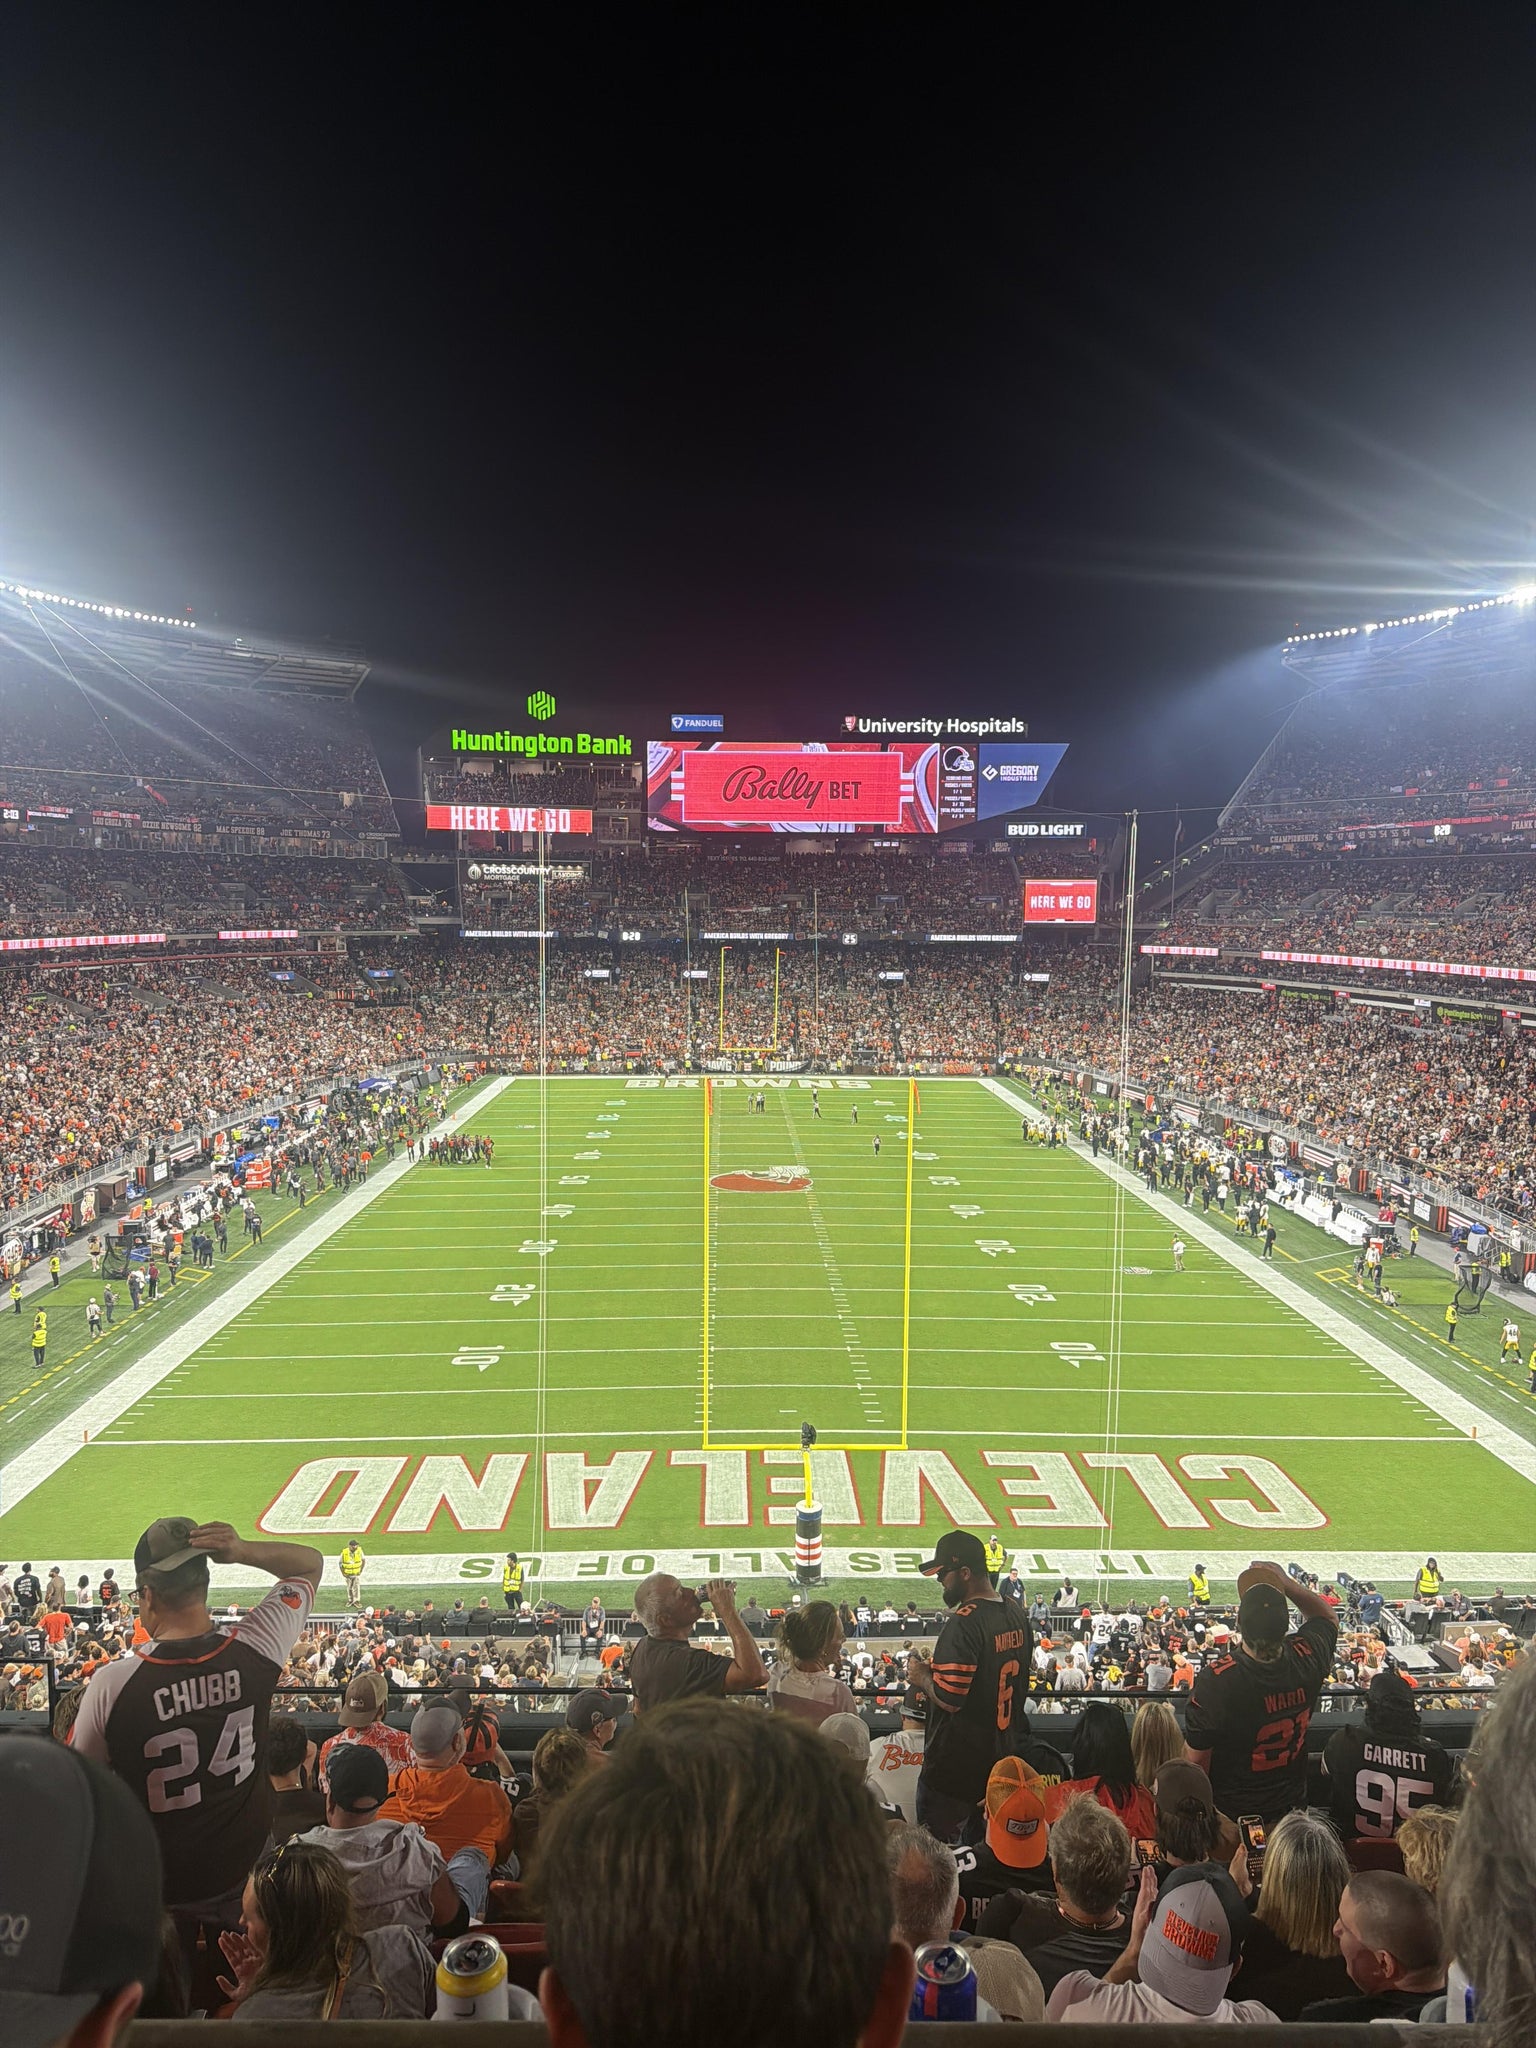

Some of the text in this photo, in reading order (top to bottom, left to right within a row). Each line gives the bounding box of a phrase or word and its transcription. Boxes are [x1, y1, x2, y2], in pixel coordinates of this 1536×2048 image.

[685, 719, 723, 728] FANDUEL
[859, 718, 1025, 737] University Hospitals
[452, 730, 632, 757] Huntington Bank
[1000, 765, 1039, 777] GREGORY
[722, 765, 862, 809] Bally BET
[161, 822, 191, 831] NEWSOME
[194, 824, 202, 832] 82
[450, 806, 571, 833] HERE WE GO
[1512, 820, 1533, 830] FRANK
[230, 826, 255, 834] SPEEDIE
[280, 829, 330, 838] JOE THOMAS 73
[1008, 824, 1084, 836] BUD LIGHT
[483, 866, 551, 875] CROSSCOUNTRY
[1031, 896, 1091, 910] HERE WE GO
[844, 934, 856, 944] 25
[624, 1078, 873, 1089] BROWNS
[489, 1284, 536, 1302] 20
[1008, 1284, 1056, 1302] 20
[451, 1345, 505, 1365] 10
[1050, 1342, 1106, 1362] 10
[255, 1448, 1329, 1535] CLEVELAND
[577, 1555, 656, 1576] OF
[849, 1552, 1061, 1574] TES
[1096, 1555, 1154, 1575] IT
[956, 1604, 978, 1616] 6
[1098, 1624, 1112, 1636] 24
[153, 1669, 242, 1722] CHUBB
[997, 1660, 1020, 1730] 6
[1264, 1688, 1306, 1714] WARD
[1252, 1709, 1312, 1772] 21
[144, 1704, 256, 1813] 24
[1364, 1744, 1427, 1772] GARRETT
[1355, 1769, 1434, 1838] 95
[1165, 1909, 1220, 1947] CLEVELAND
[1162, 1922, 1217, 1961] BROWNS
